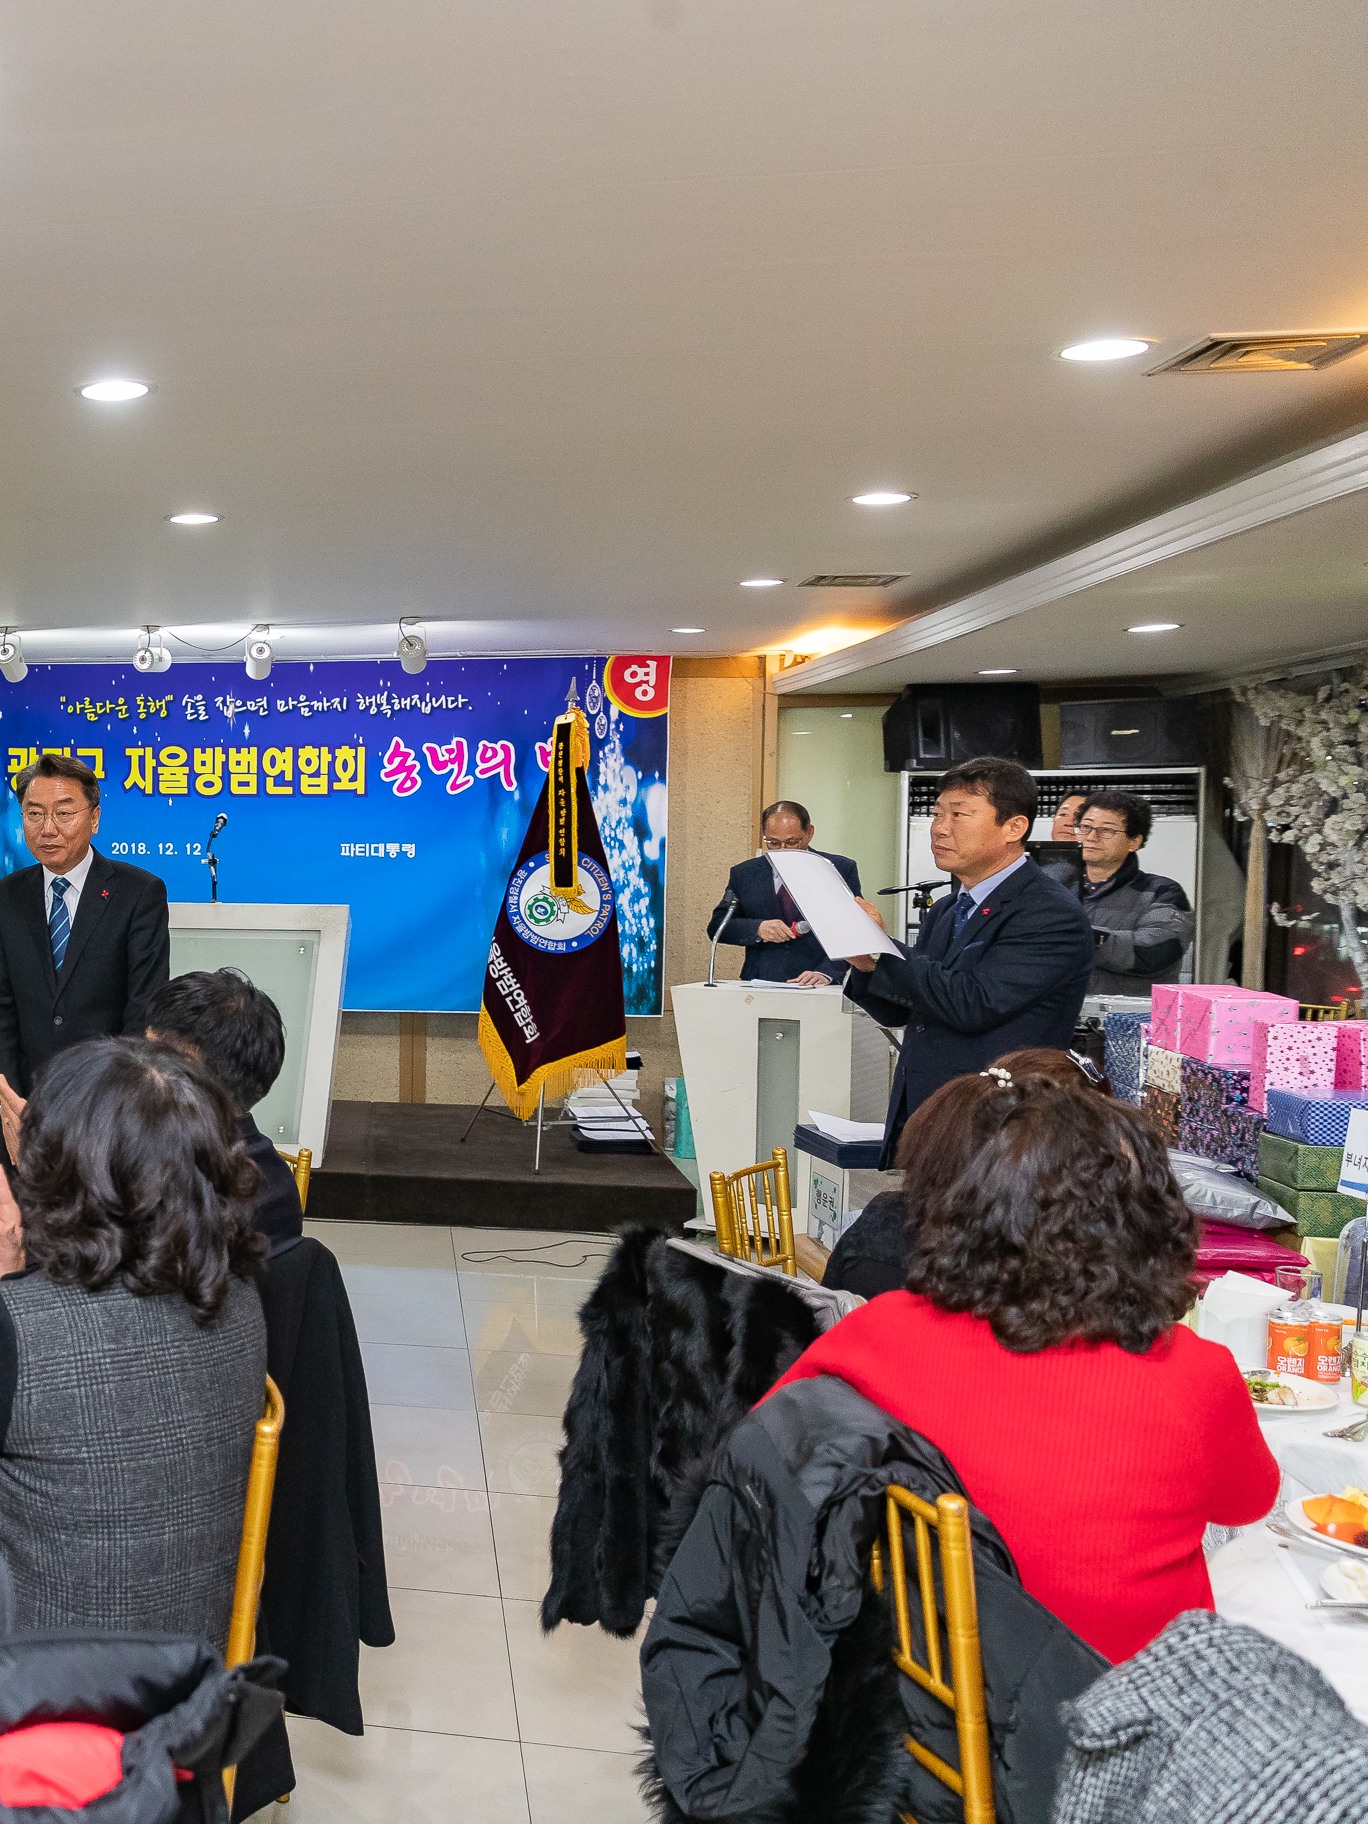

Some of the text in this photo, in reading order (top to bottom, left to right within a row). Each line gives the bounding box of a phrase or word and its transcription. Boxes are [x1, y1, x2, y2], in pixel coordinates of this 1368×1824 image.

[623, 660, 657, 701] 영
[182, 694, 209, 721] 손을
[215, 694, 269, 720] 잡으면
[277, 693, 348, 717] 마음까지
[356, 691, 473, 718] 행복해집니다.
[124, 745, 366, 796] 자율방범연합회
[380, 736, 517, 798] 송년의
[111, 843, 151, 855] 2018.
[158, 843, 178, 855] 12.
[340, 842, 416, 859] 파티대통령
[509, 869, 528, 914] 광진경찰서
[581, 857, 612, 938] CITIZEN'S PATROL
[512, 914, 566, 951] 자율방범연합회
[1276, 1364, 1305, 1374] ORANGE
[1277, 1356, 1305, 1367] 오렌지
[1316, 1364, 1341, 1372] ORANG
